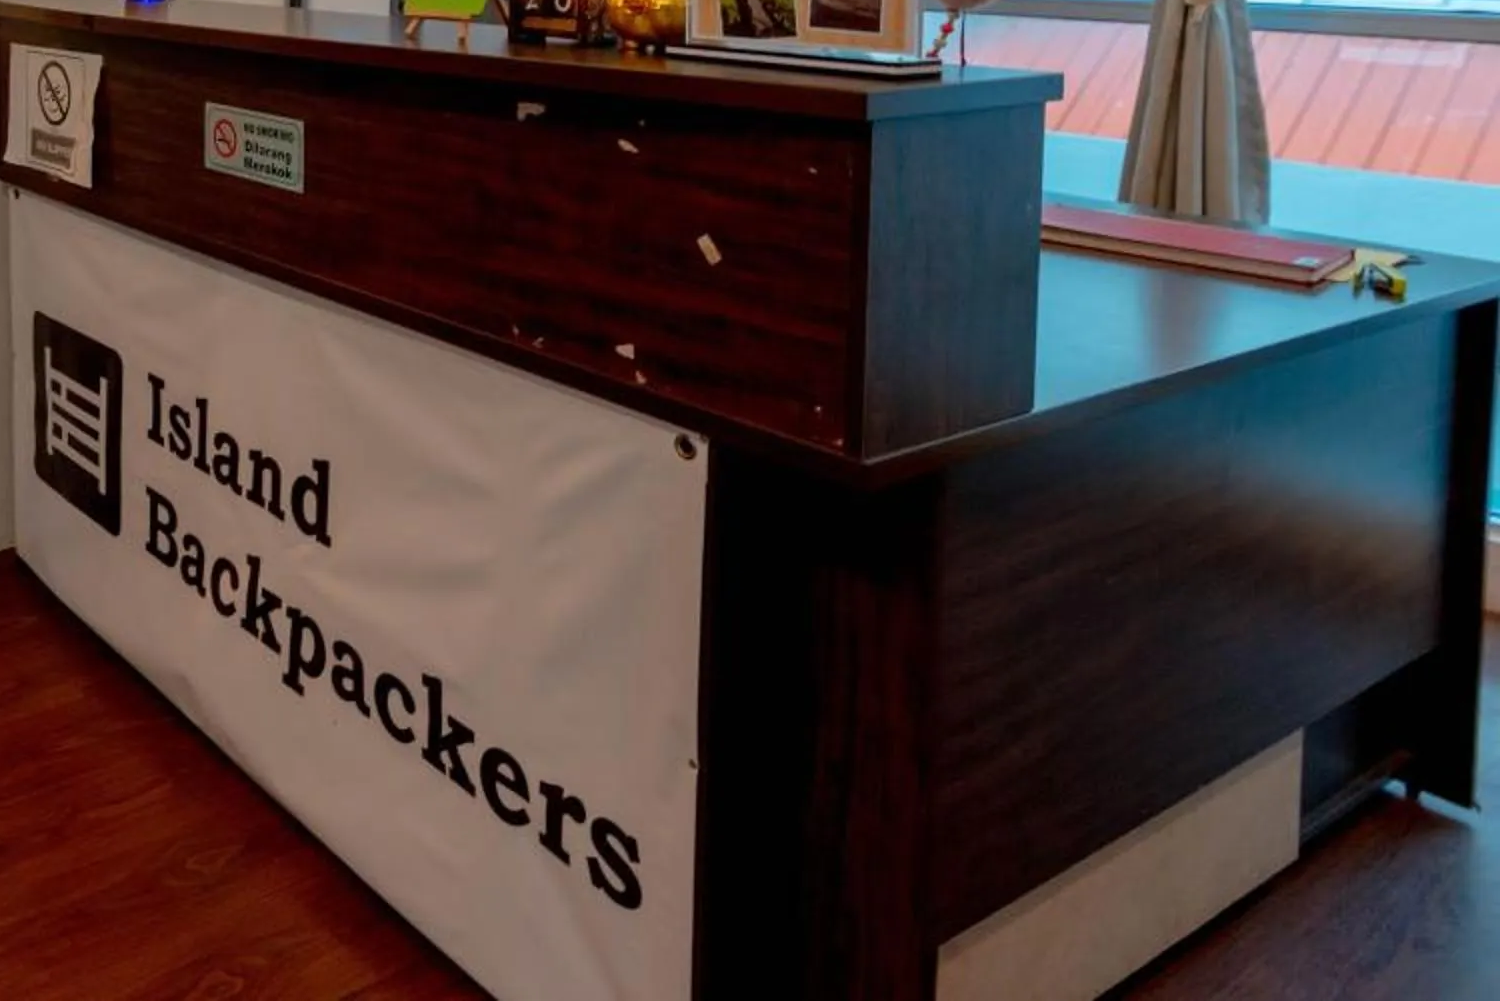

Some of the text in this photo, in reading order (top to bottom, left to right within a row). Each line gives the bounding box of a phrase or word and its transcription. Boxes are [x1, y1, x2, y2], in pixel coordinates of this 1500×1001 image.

[244, 139, 293, 166] Dilarang
[146, 372, 332, 548] Island
[144, 485, 643, 911] Backpackers
